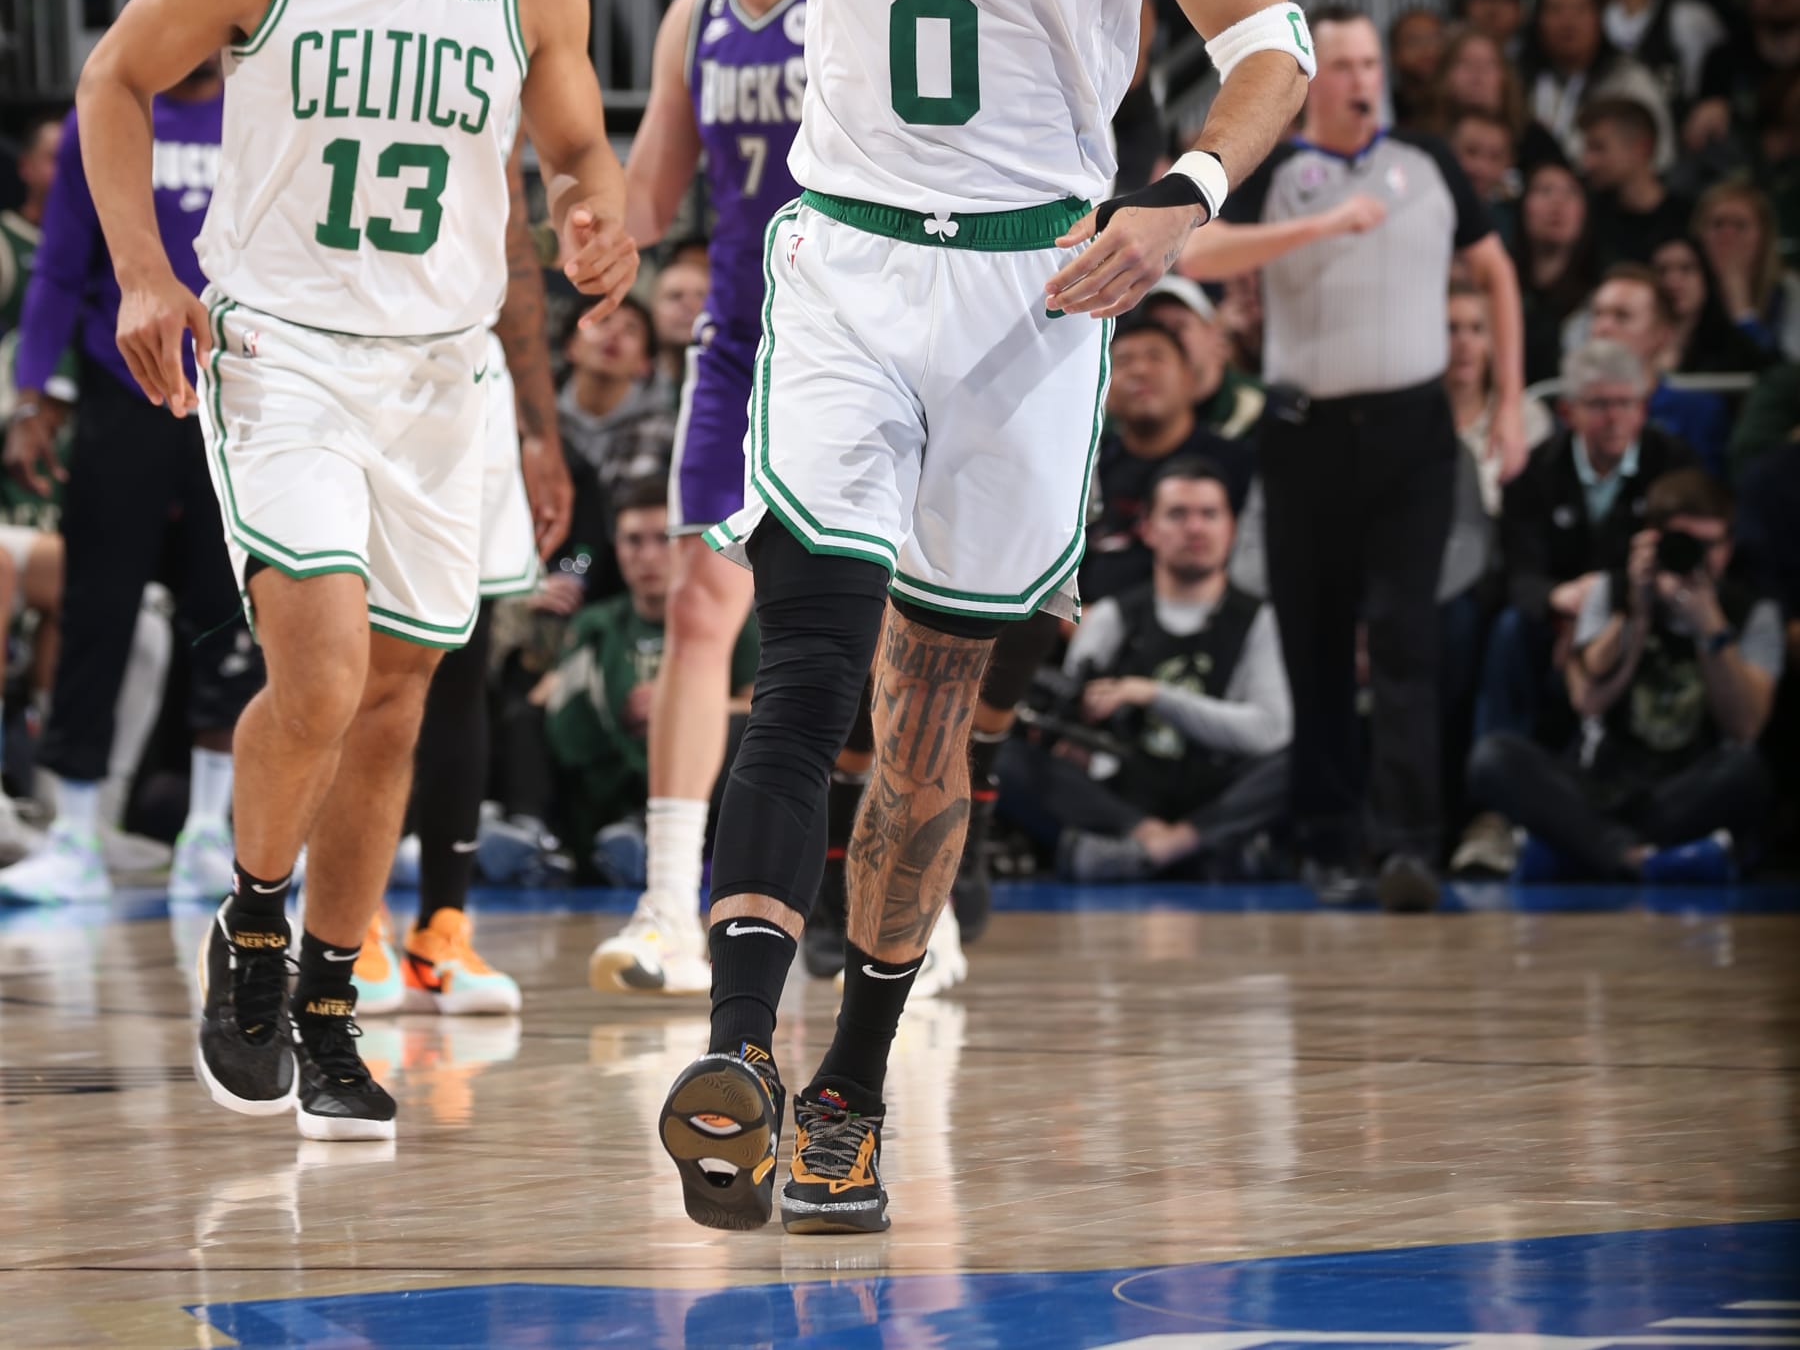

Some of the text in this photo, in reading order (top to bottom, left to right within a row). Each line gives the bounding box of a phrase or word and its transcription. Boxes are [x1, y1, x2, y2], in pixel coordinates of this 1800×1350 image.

[291, 29, 494, 135] CELTICS
[315, 137, 450, 254] 13
[737, 136, 767, 197] 7
